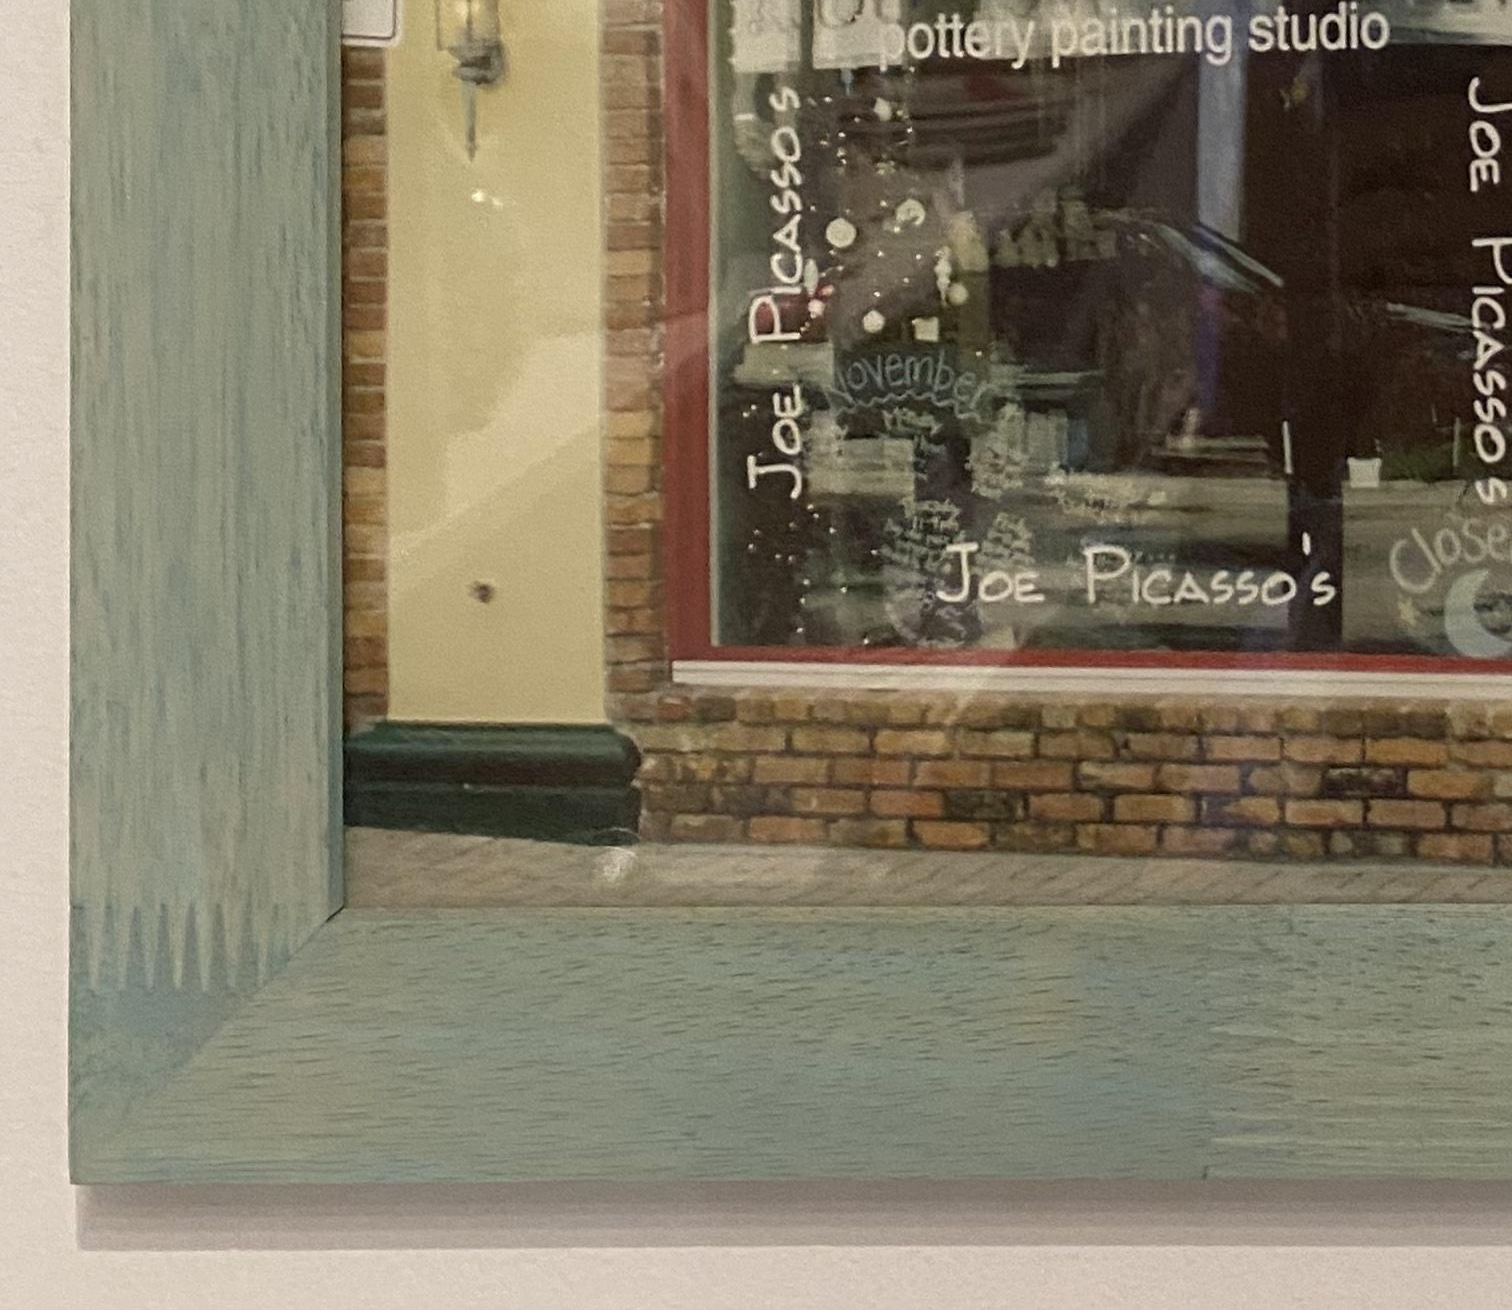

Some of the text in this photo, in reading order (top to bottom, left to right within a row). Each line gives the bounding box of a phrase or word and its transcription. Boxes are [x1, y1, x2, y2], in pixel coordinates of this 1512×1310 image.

[878, 4, 1390, 73] pottery painting studio
